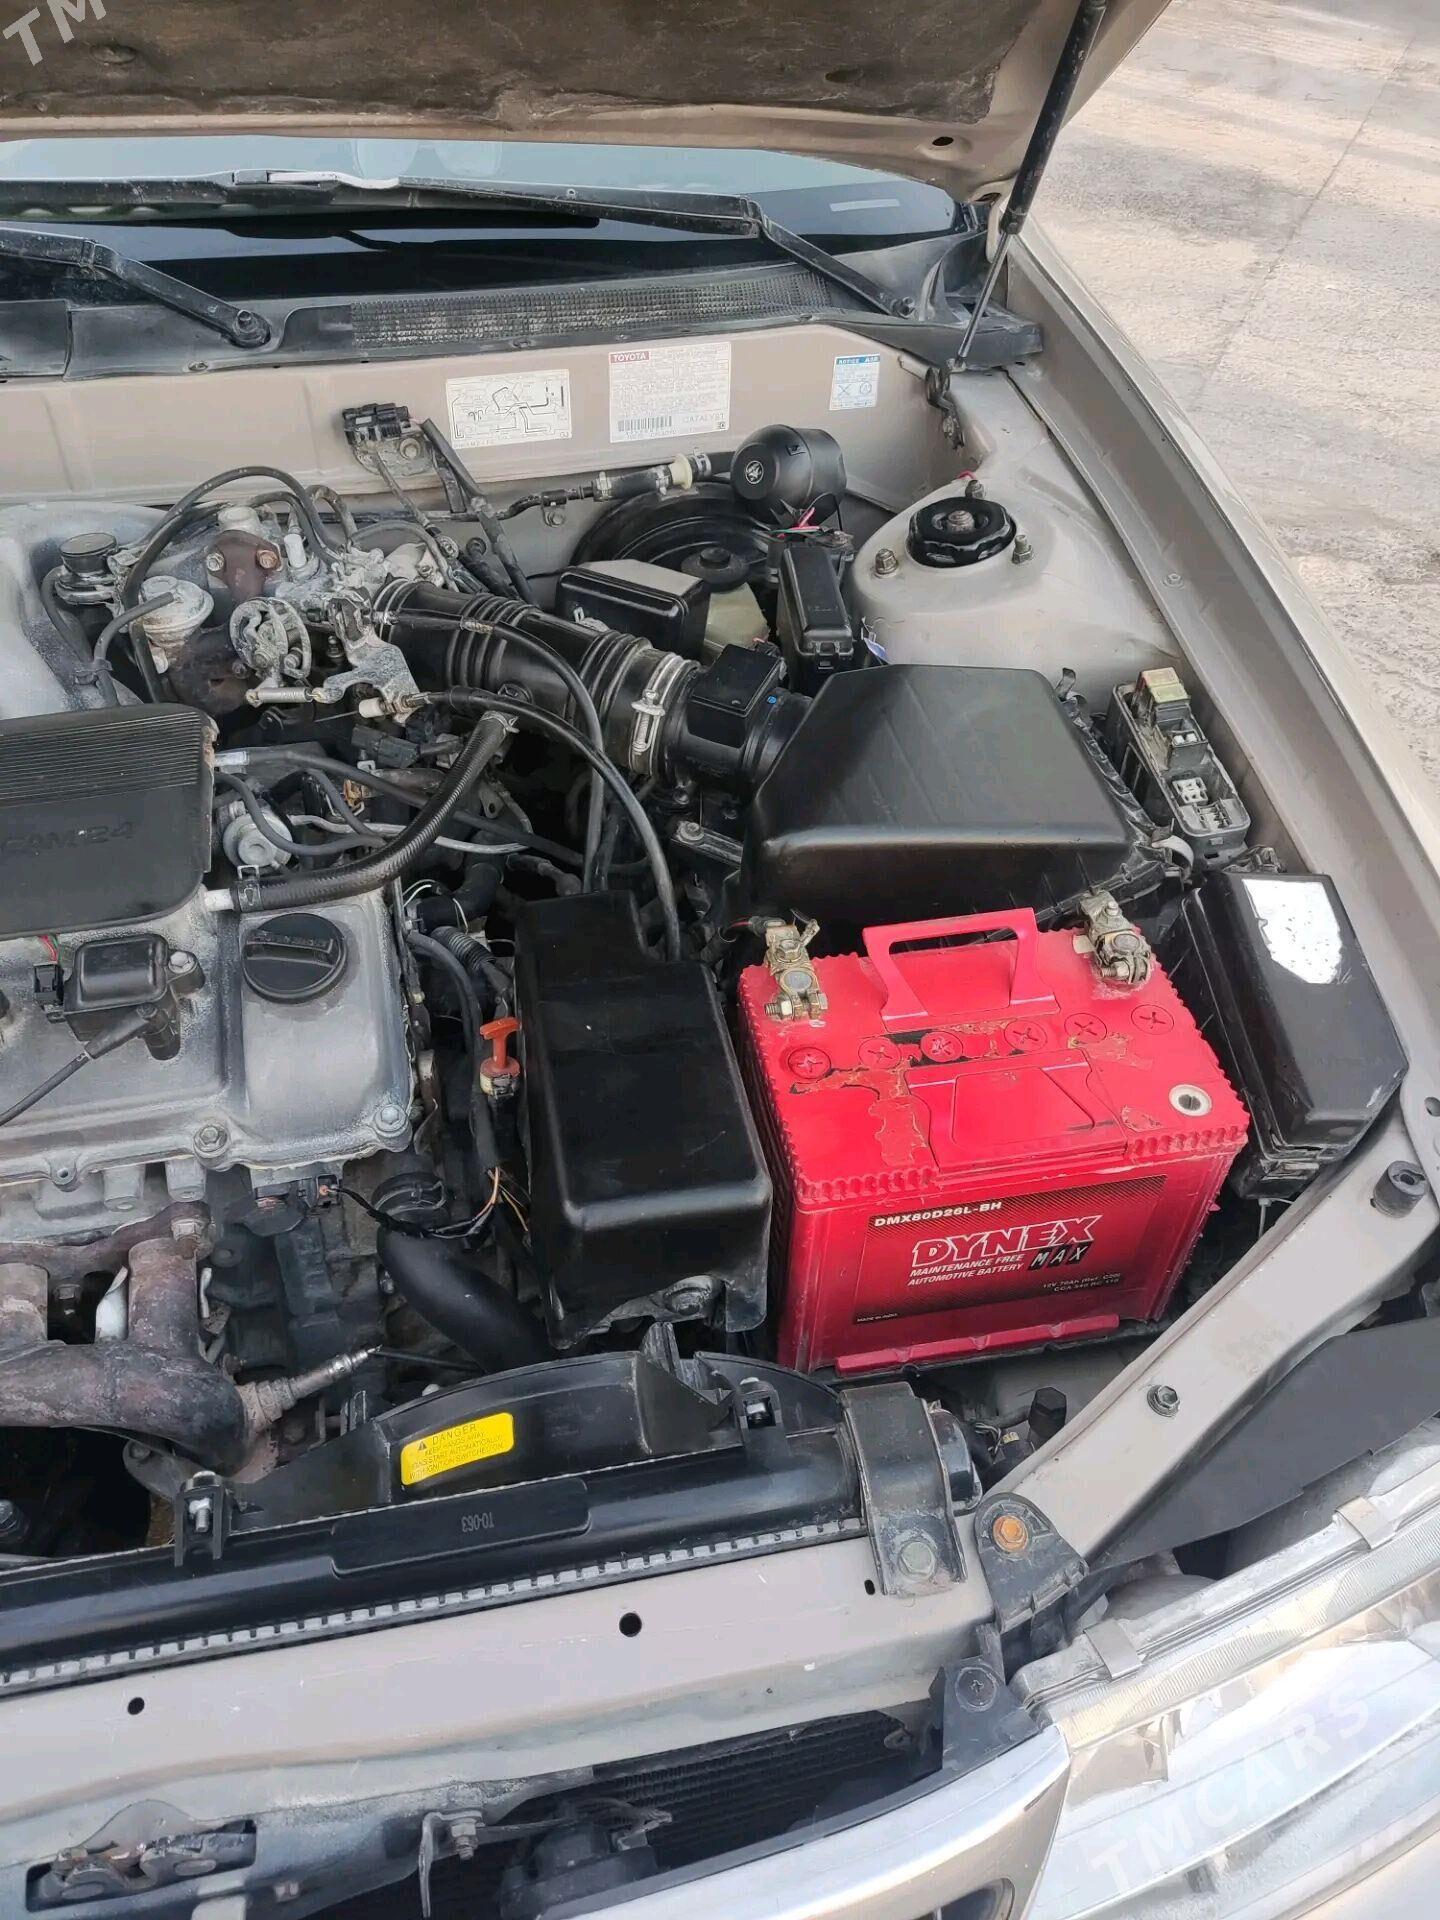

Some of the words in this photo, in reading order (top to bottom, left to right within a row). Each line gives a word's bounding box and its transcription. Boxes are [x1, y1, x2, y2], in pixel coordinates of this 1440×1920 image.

[612, 352, 646, 362] TOYOTA
[874, 1201, 1002, 1228] DMX80D26L-BH
[911, 1214, 1103, 1268] DYNEX
[909, 1258, 993, 1277] MAINTENANCE
[995, 1254, 1025, 1264] FREE
[1030, 1245, 1088, 1269] MAX
[907, 1269, 976, 1287] AUTOMOTIVE
[976, 1263, 1024, 1277] BATTERY
[432, 1423, 477, 1446] DANGER
[424, 1445, 442, 1456] KEEP
